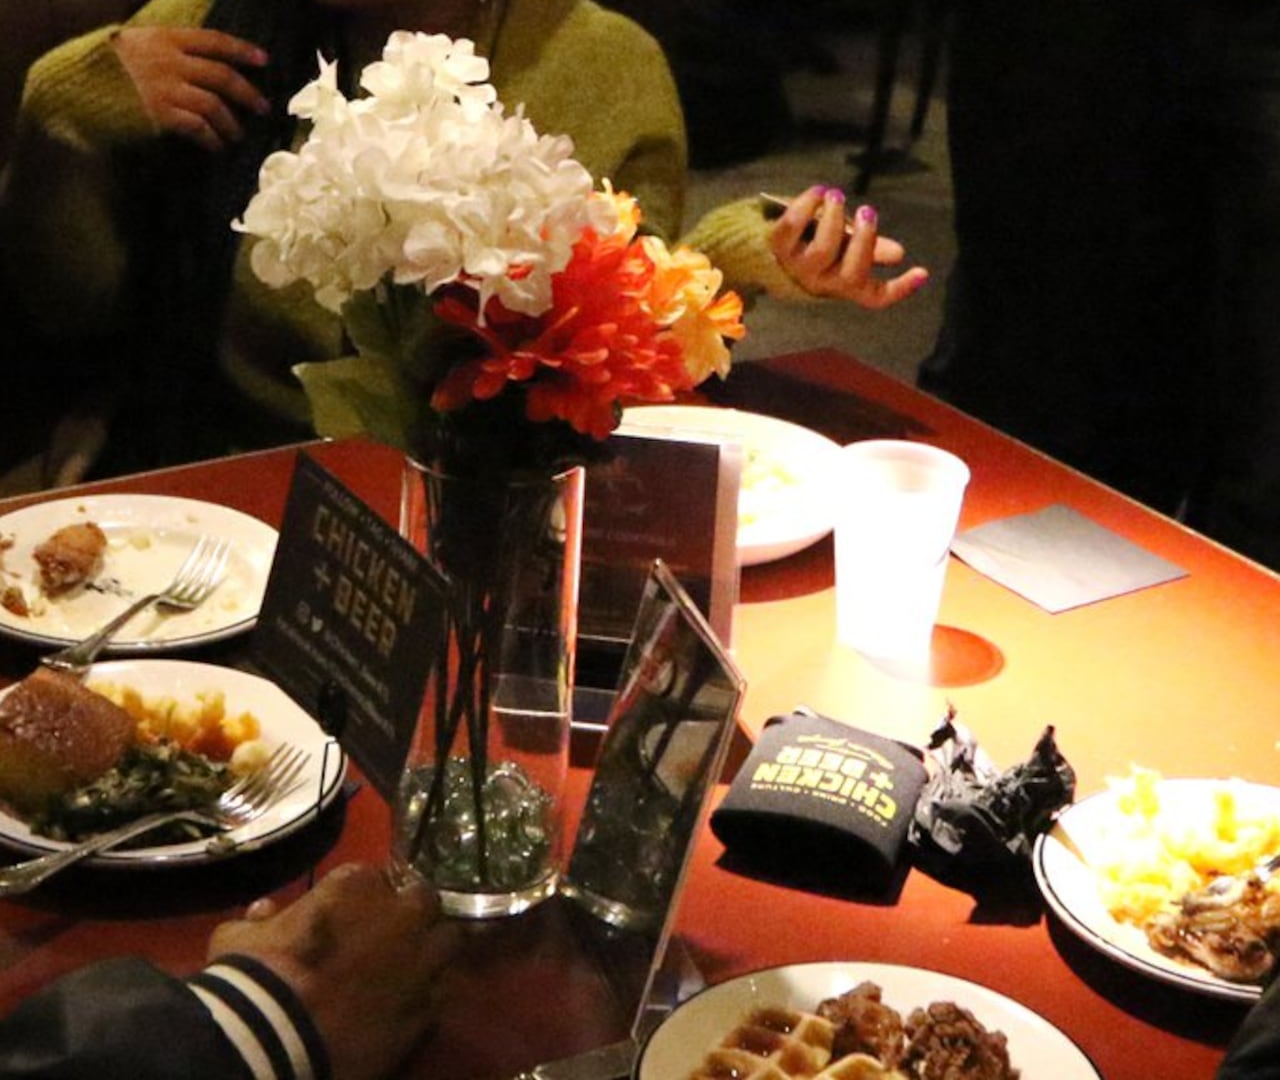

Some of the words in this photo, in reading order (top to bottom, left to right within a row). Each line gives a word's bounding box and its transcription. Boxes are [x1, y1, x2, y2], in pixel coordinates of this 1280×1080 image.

[312, 504, 417, 625] CHICKEN
[333, 575, 396, 657] BEER
[752, 762, 897, 820] CHICKEN
[776, 745, 867, 780] BEER
